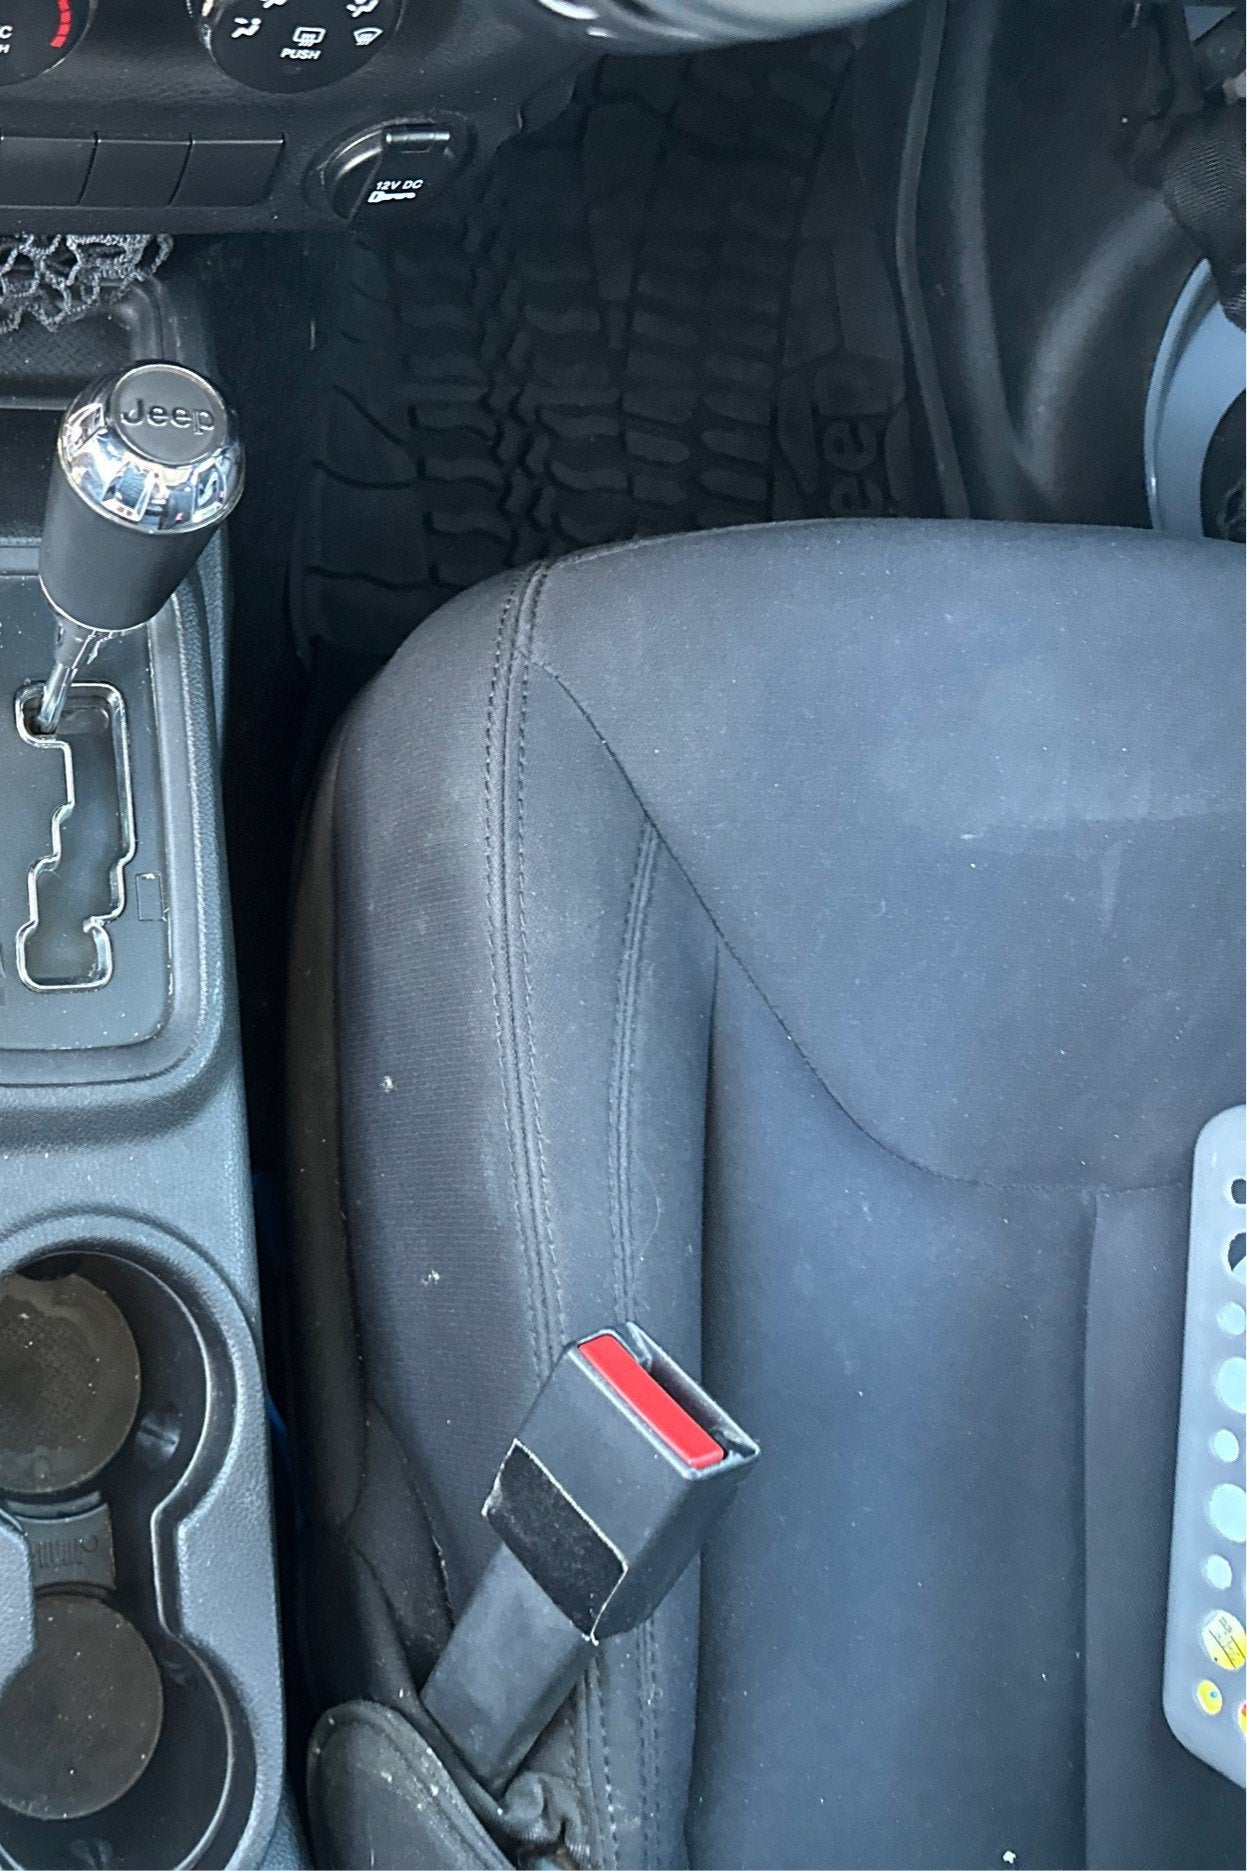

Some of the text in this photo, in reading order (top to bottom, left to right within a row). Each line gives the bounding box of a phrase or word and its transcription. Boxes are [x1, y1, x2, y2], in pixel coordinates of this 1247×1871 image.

[280, 48, 321, 60] PUSH
[376, 179, 424, 190] 12V DC
[120, 398, 215, 435] Jeep
